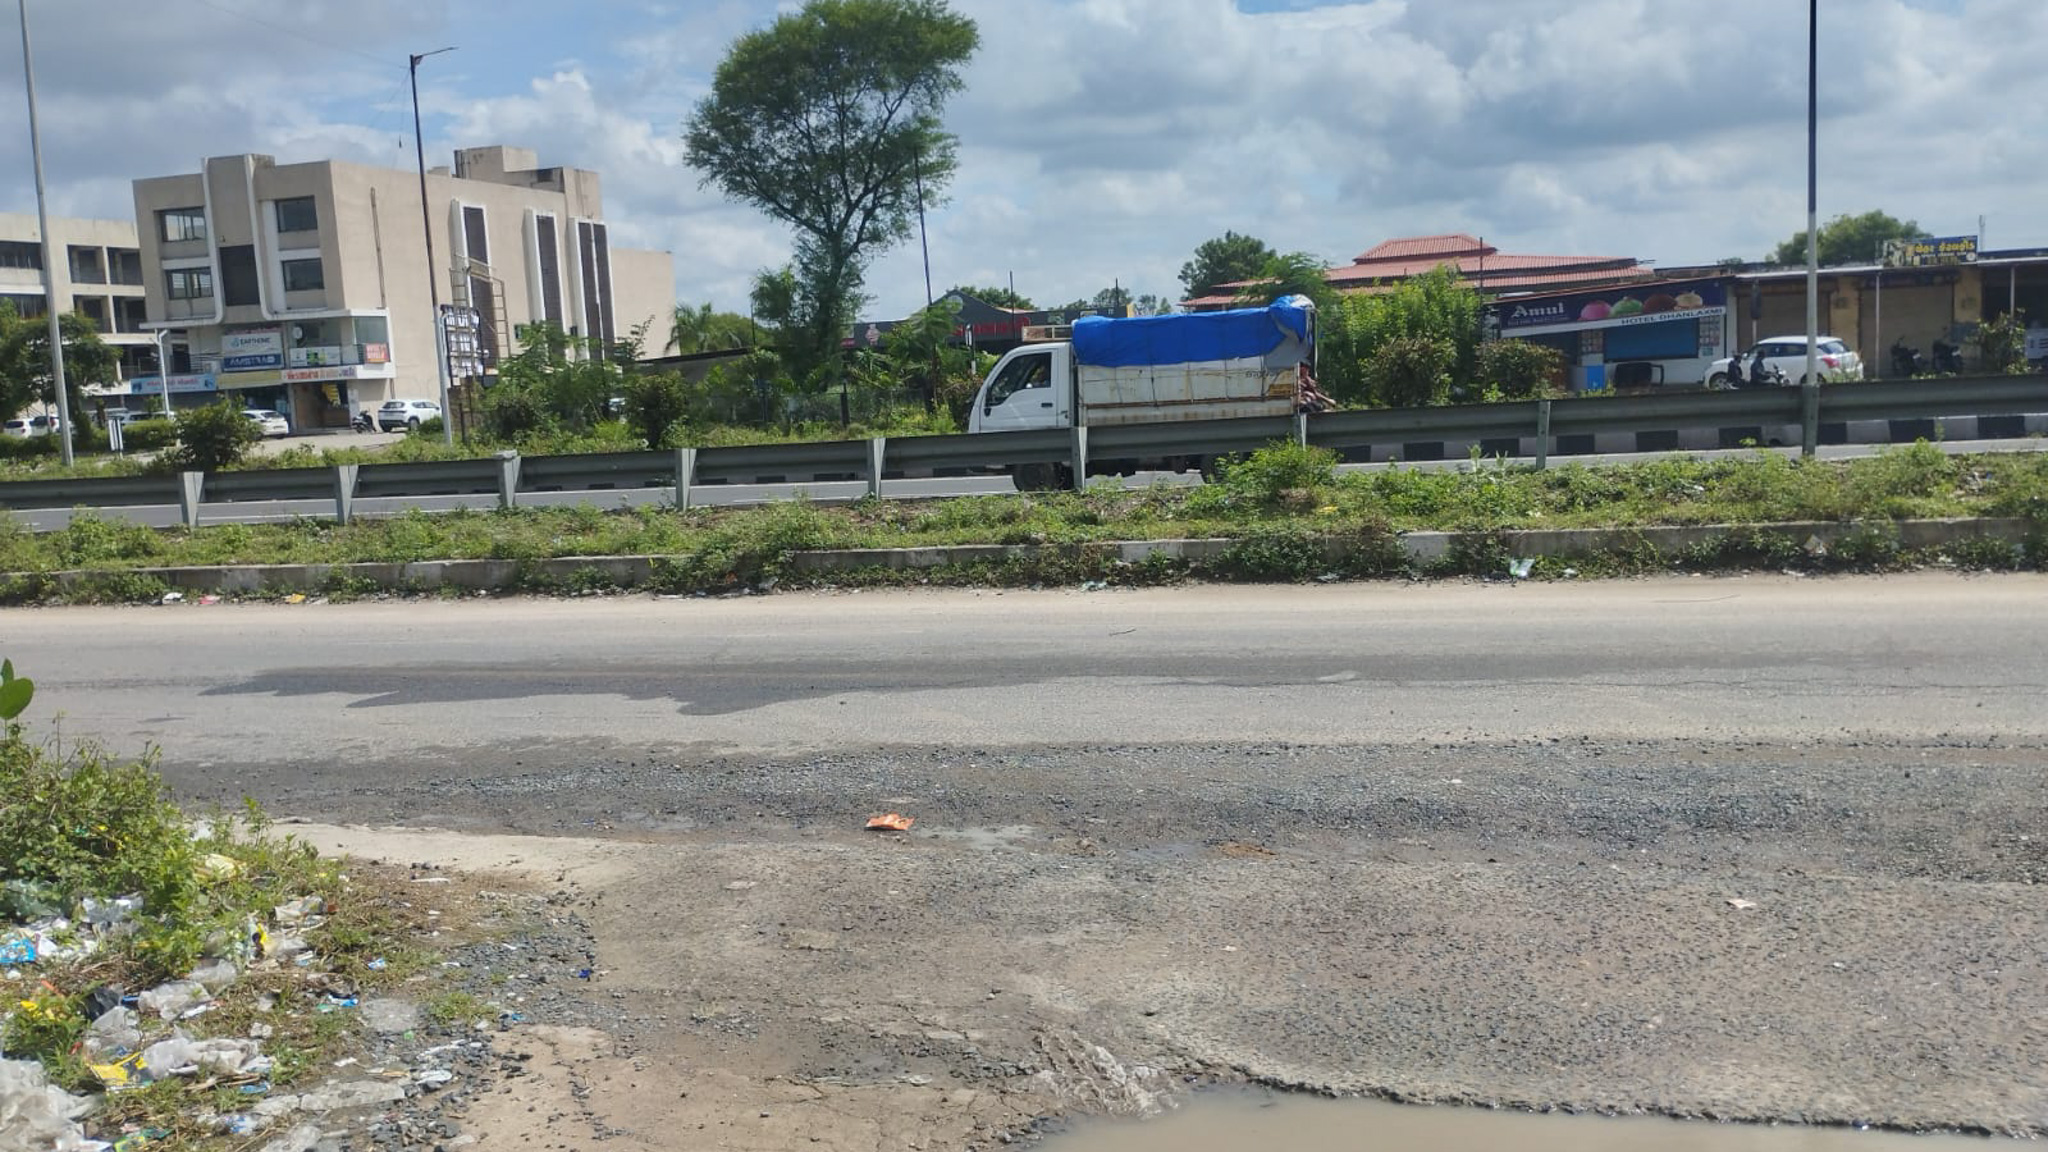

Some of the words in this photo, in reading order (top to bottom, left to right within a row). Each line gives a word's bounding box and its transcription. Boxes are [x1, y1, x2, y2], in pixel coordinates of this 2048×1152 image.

[1511, 302, 1565, 318] Amul
[1621, 315, 1656, 325] HOTEL
[1659, 308, 1723, 321] DHANLAXMI
